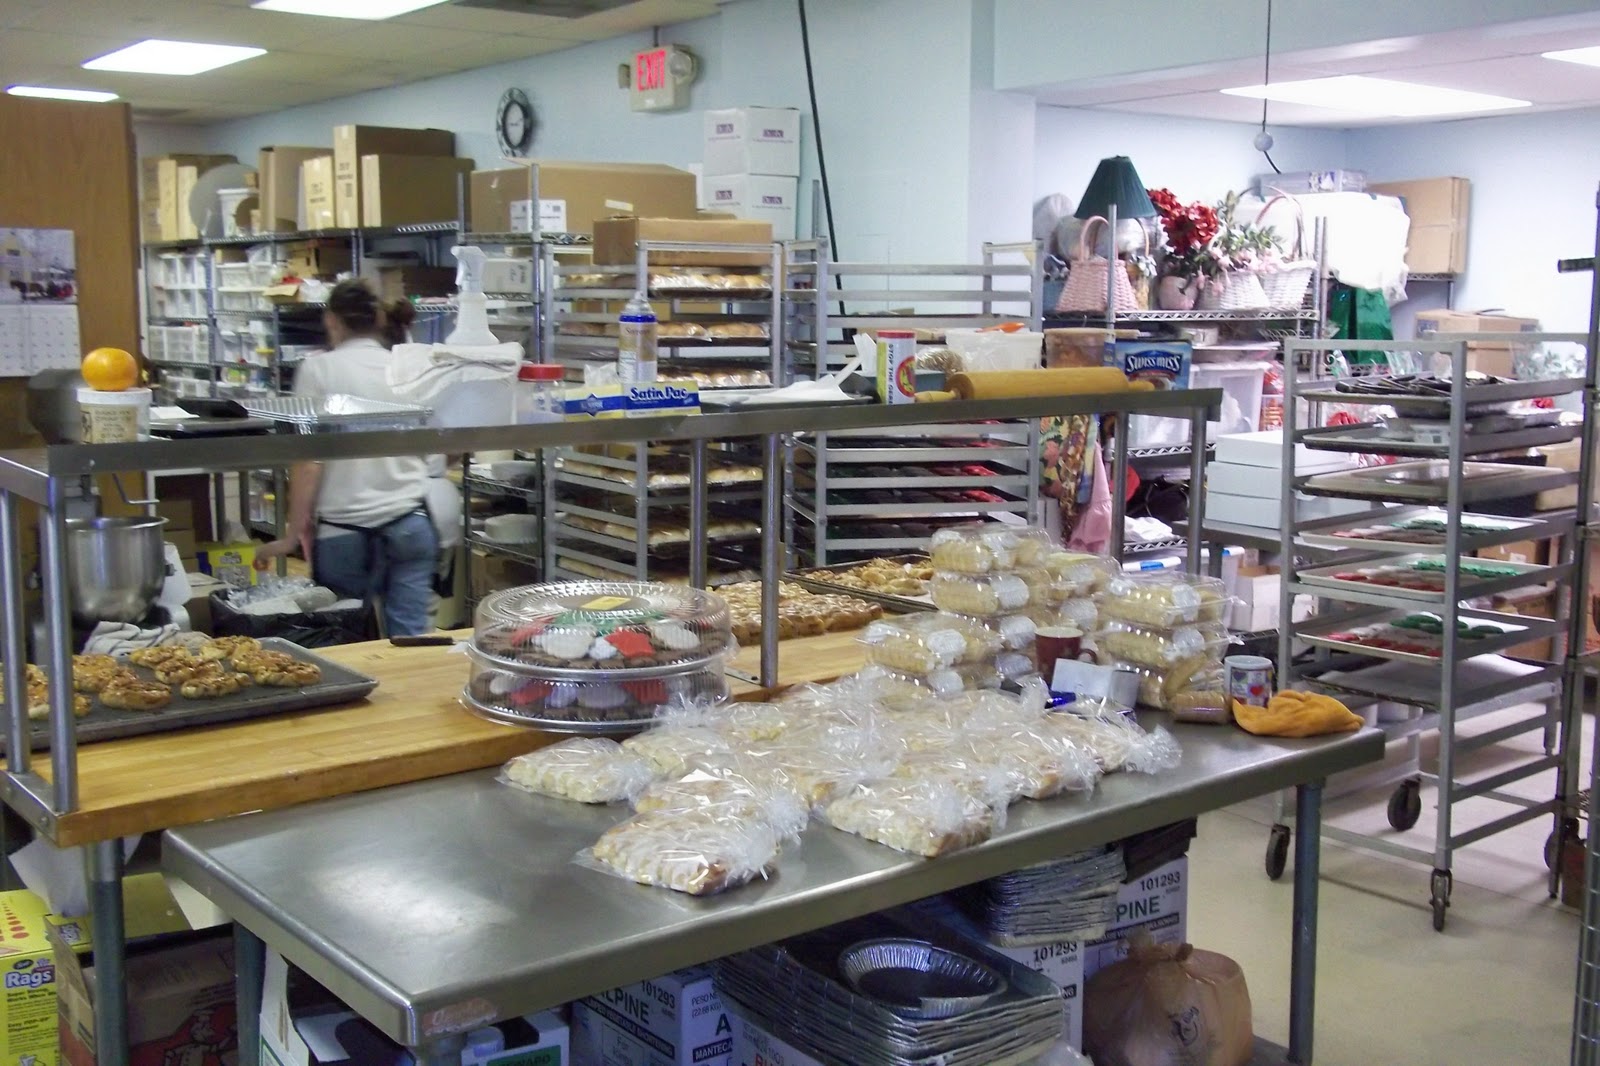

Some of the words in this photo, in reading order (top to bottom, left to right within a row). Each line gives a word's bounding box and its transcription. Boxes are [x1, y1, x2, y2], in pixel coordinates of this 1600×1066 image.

[636, 49, 667, 92] EXIT
[630, 386, 665, 402] Satin
[665, 386, 690, 400] Pac
[1139, 871, 1181, 891] 101293
[1115, 895, 1160, 923] PINE
[1033, 941, 1078, 963] 101293
[5, 970, 53, 989] Rags
[641, 979, 676, 1009] 101293
[601, 988, 650, 1025] LPINE
[715, 1012, 732, 1036] A
[695, 1040, 733, 1060] MANTECA
